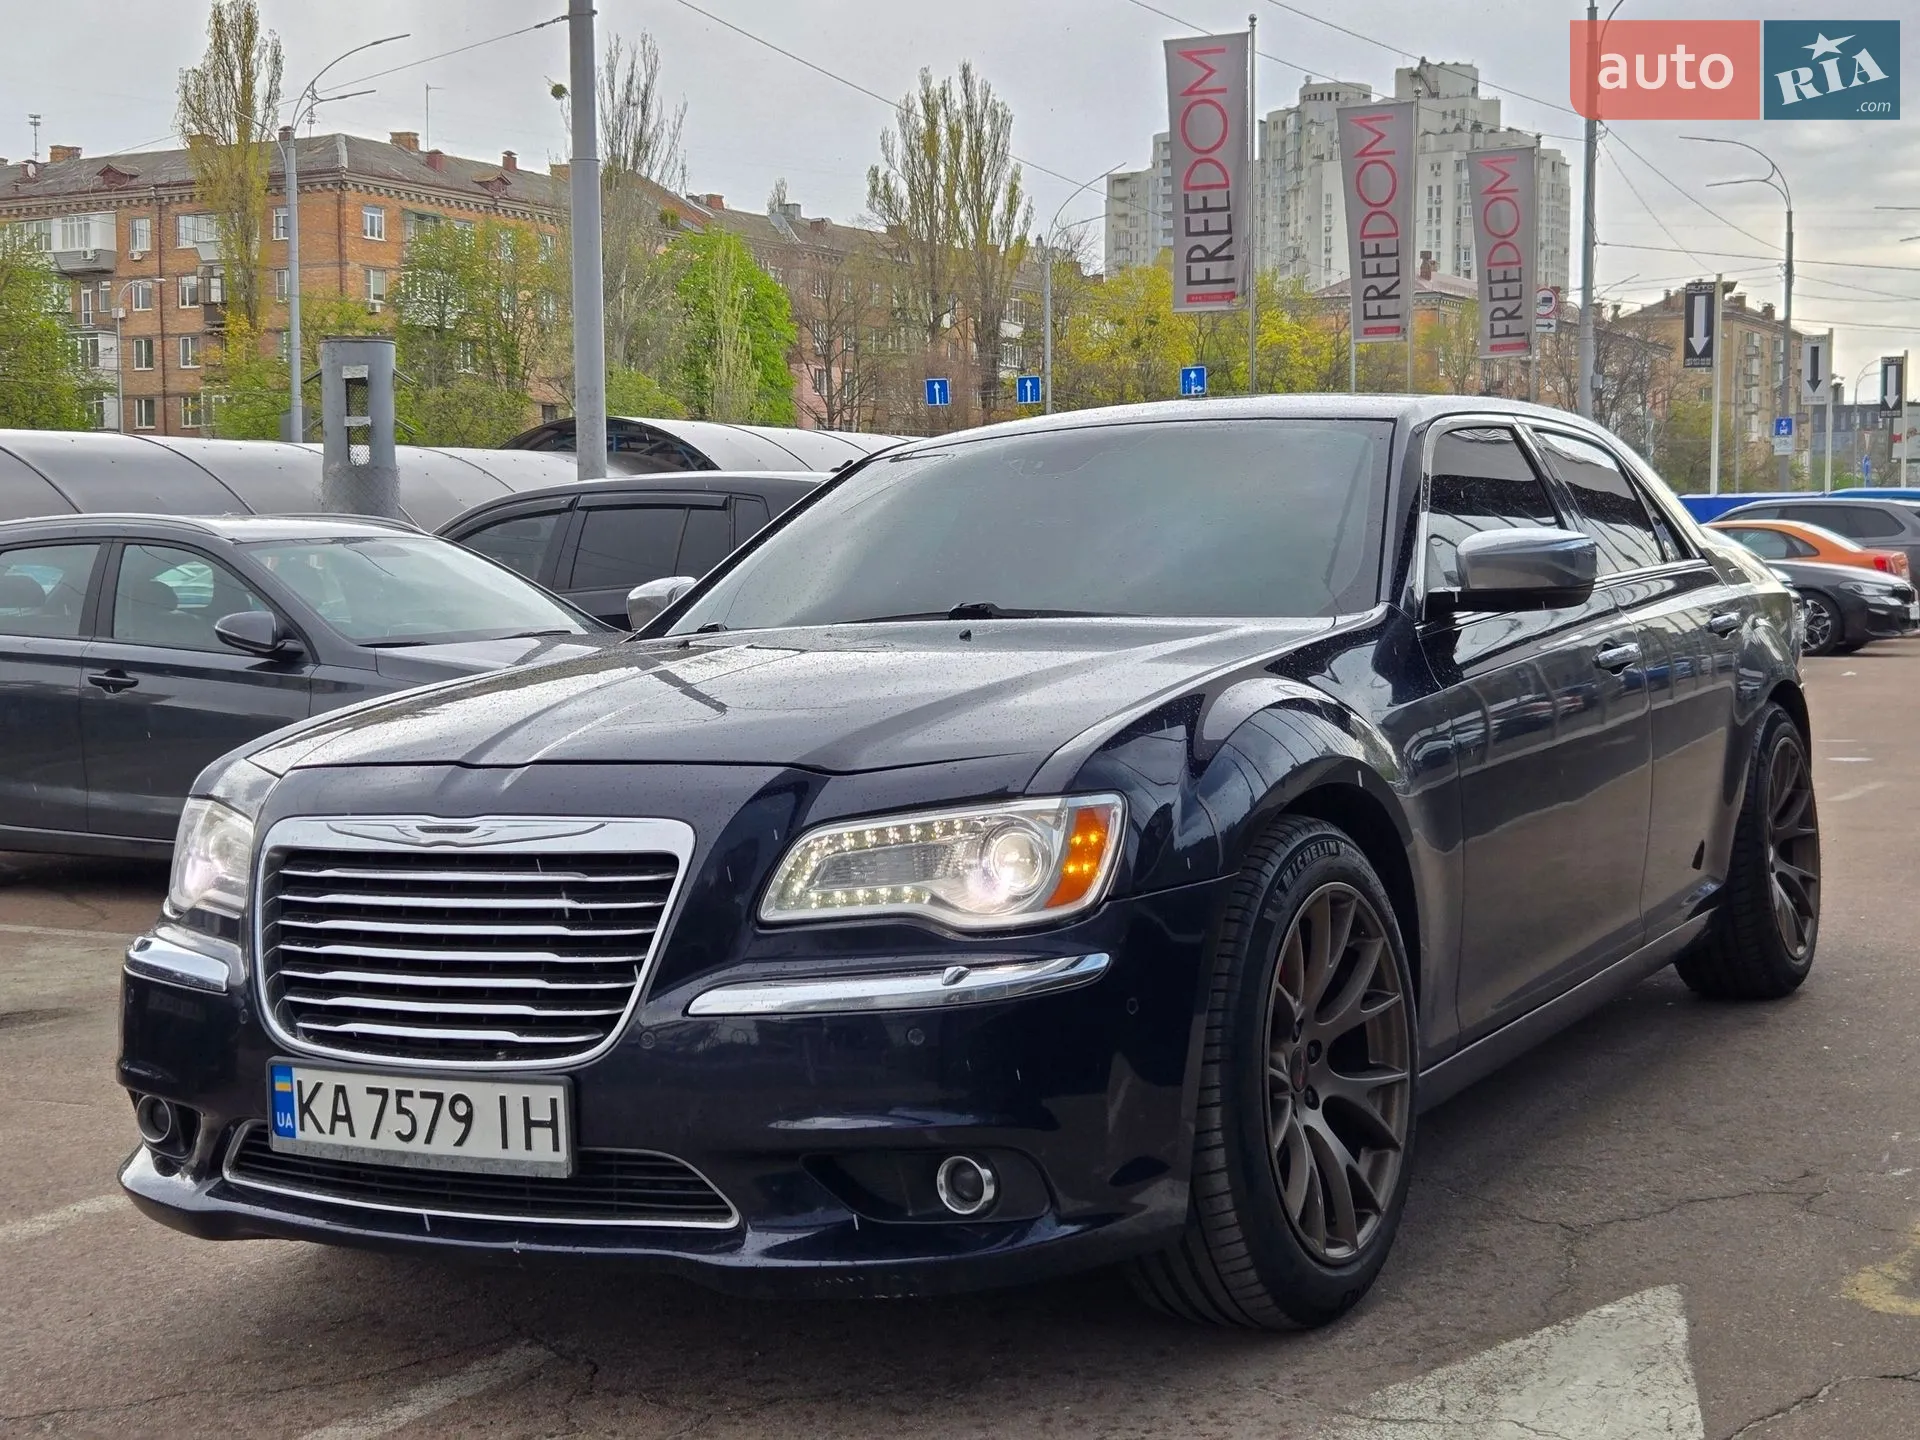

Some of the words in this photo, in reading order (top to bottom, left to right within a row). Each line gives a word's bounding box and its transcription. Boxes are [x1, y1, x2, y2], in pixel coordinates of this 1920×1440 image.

[1177, 47, 1235, 286] FREEDOM
[1350, 114, 1400, 320] FREEDOM
[1478, 156, 1526, 340] FREEDOM
[1282, 840, 1338, 890] MICHELIN
[276, 1111, 294, 1129] UA
[296, 1079, 356, 1138] KA
[365, 1086, 474, 1147] 7579
[498, 1095, 560, 1152] IH
